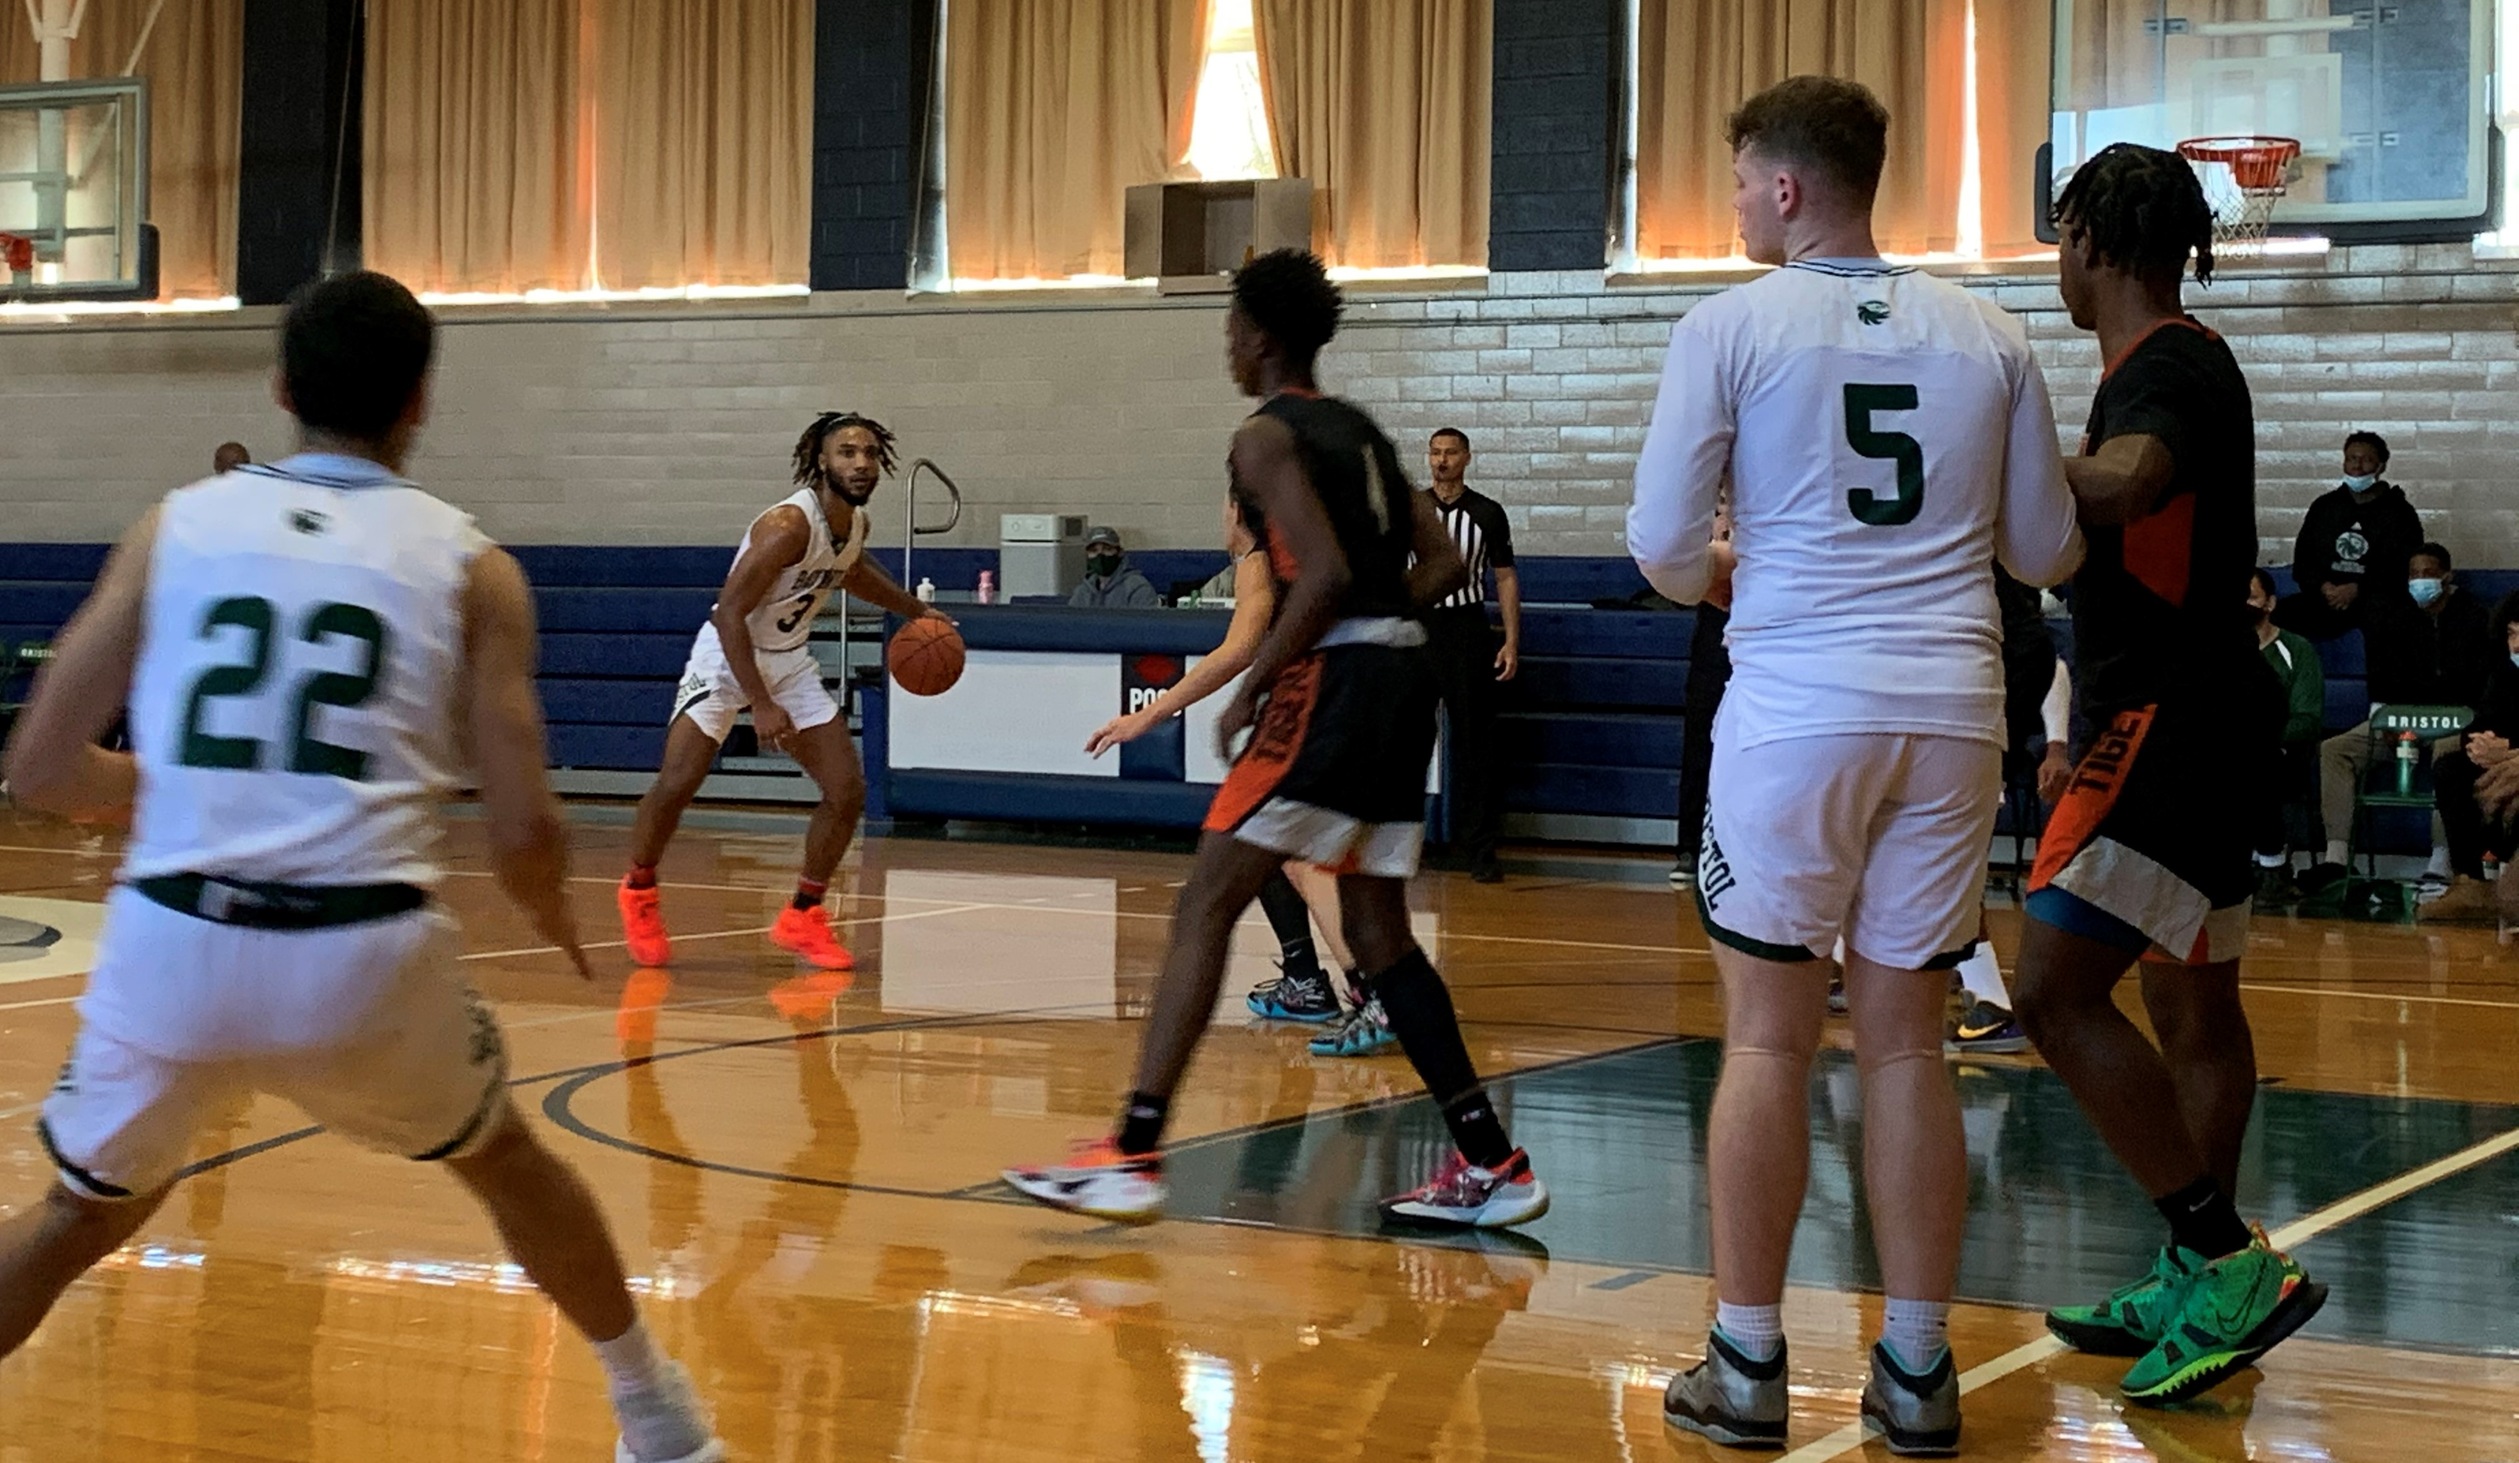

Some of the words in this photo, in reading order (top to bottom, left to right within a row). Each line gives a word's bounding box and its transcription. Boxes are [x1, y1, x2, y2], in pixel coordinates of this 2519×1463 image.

[1843, 383, 1924, 525] 5
[777, 594, 815, 633] 3
[176, 596, 388, 782] 22
[2387, 715, 2462, 729] BRISTOL
